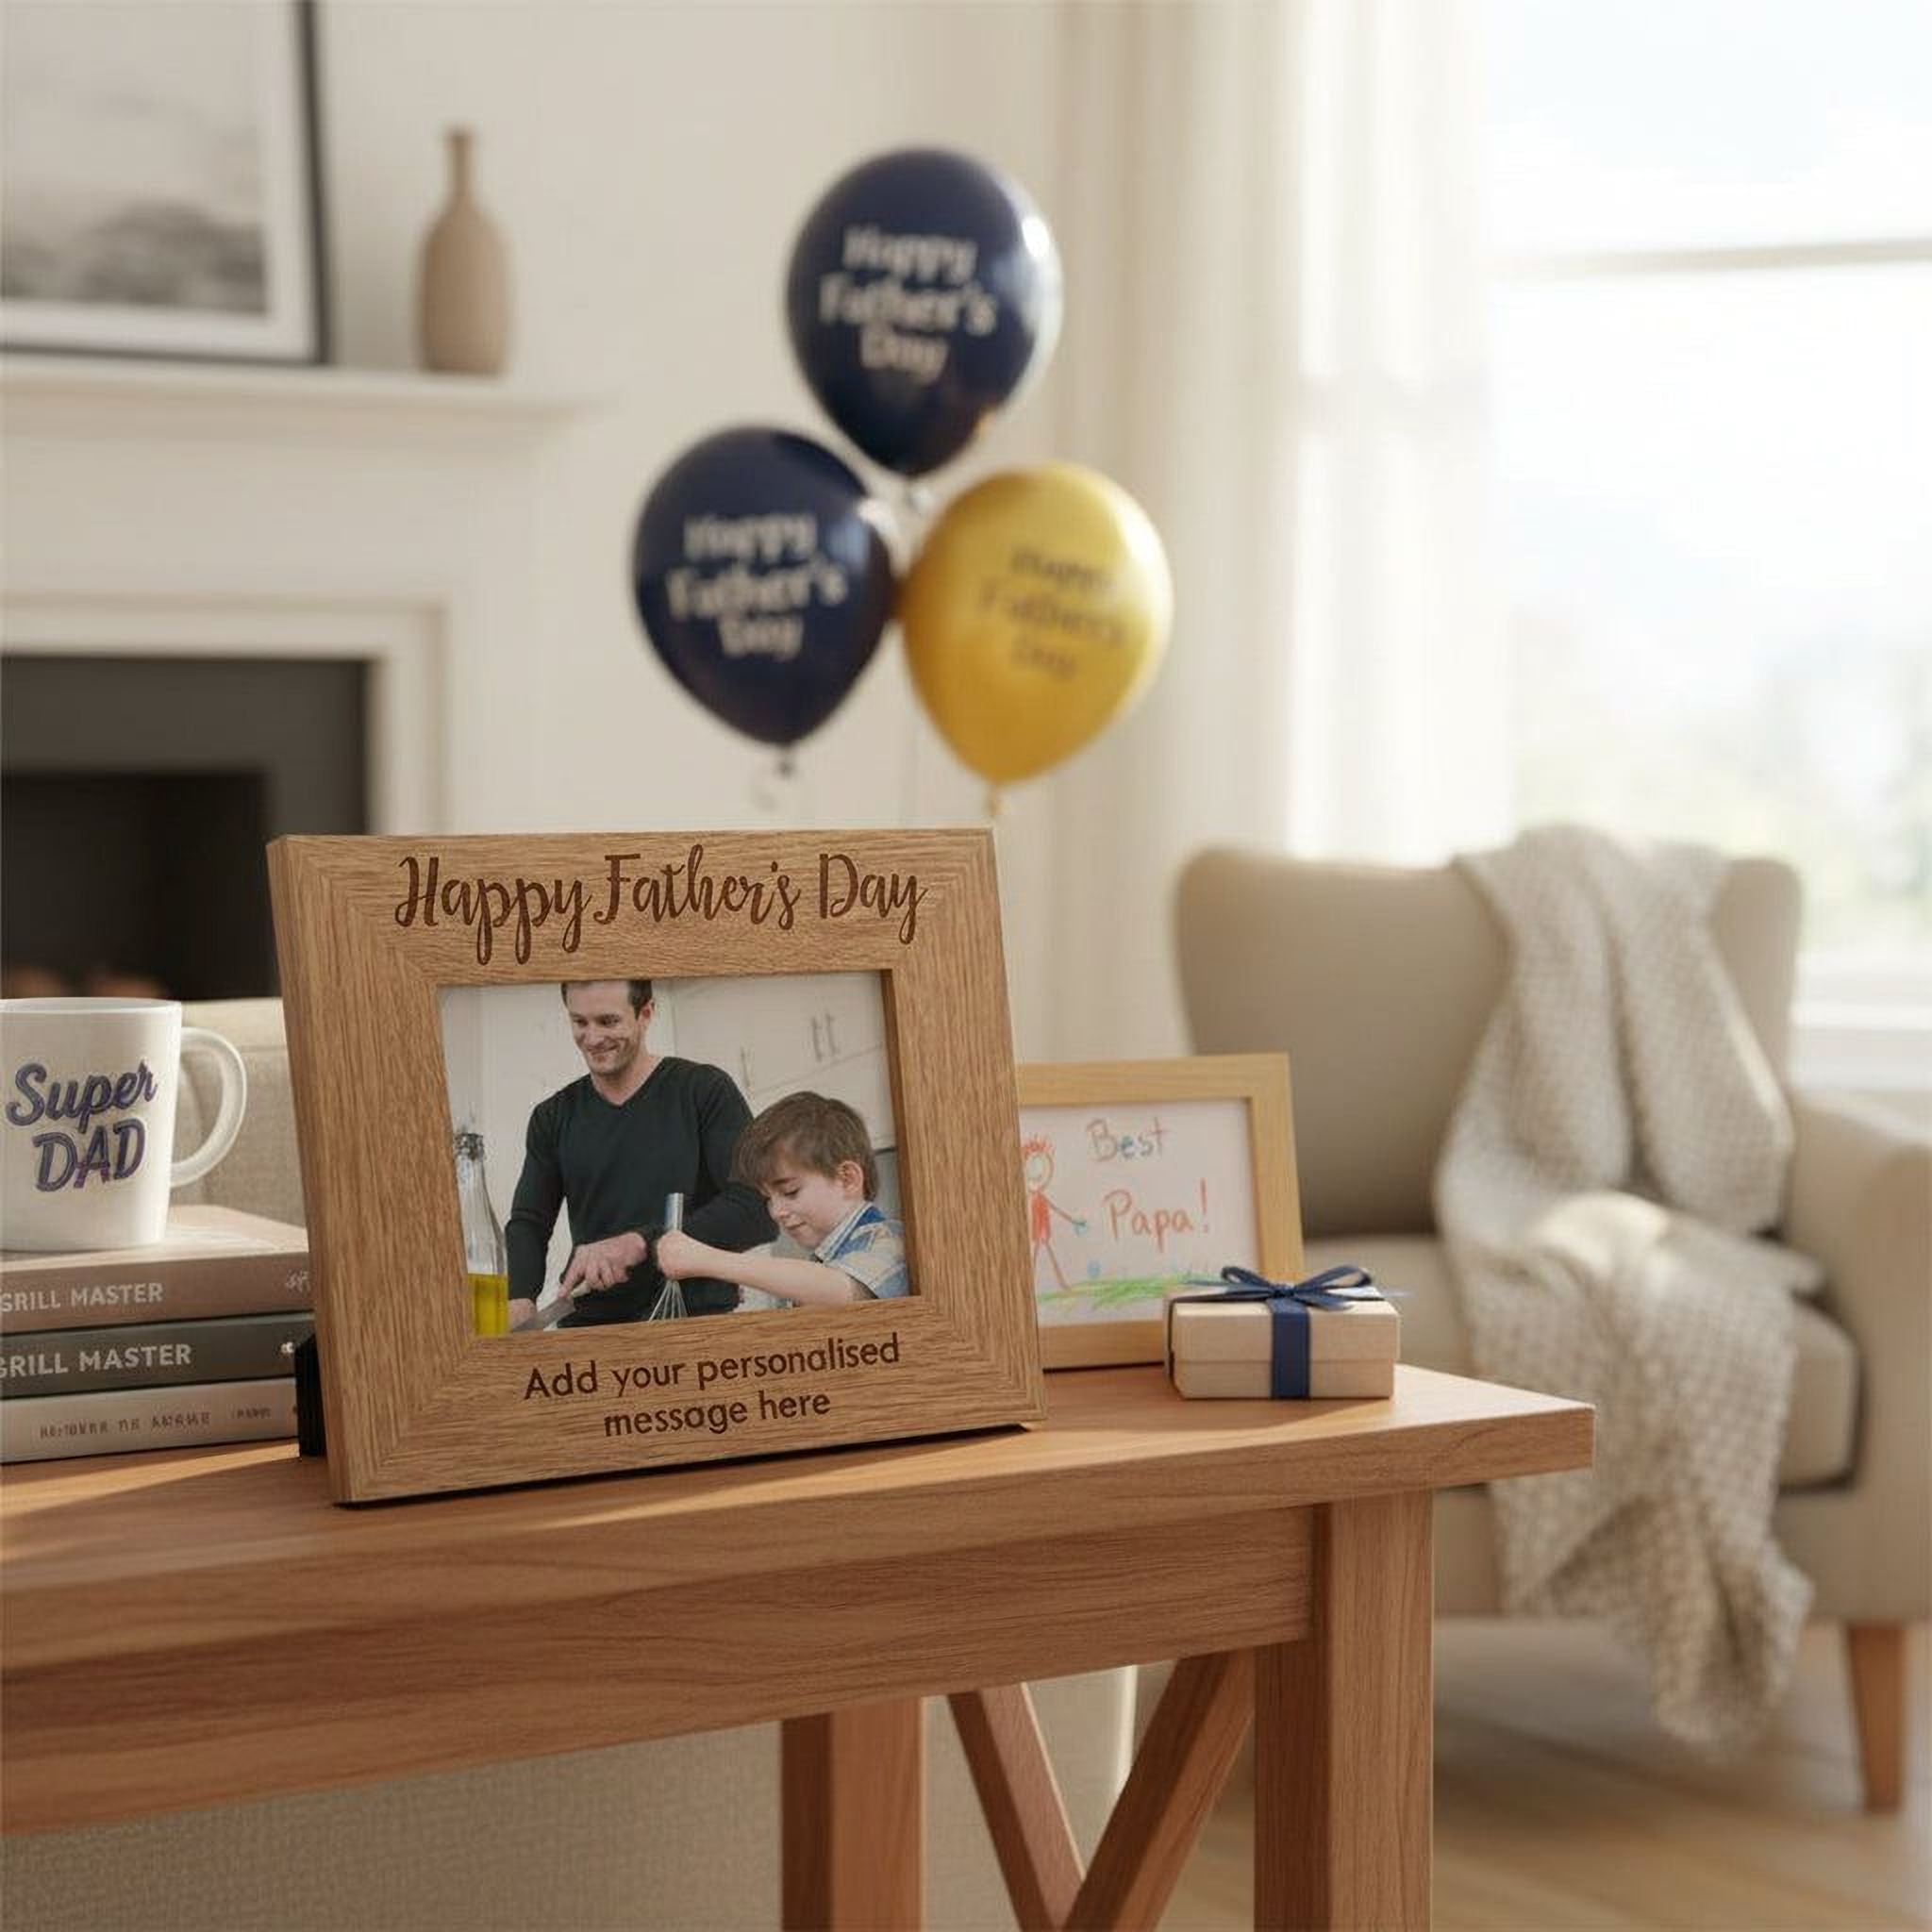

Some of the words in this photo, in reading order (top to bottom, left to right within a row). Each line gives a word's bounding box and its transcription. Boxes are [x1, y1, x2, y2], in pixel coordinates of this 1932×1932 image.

[843, 225, 977, 285] Happy
[394, 856, 591, 965] Happy
[592, 843, 801, 930] Father's
[819, 853, 928, 945] Day
[6, 1059, 158, 1134] Super
[32, 1116, 147, 1192] DAD
[1087, 1116, 1173, 1162] Best
[1104, 1178, 1210, 1253] Papa!
[71, 1282, 164, 1307] MASTER
[78, 1343, 192, 1373] MASTER
[524, 1359, 598, 1400] Add
[611, 1362, 684, 1397] your
[697, 1331, 900, 1391] personalised
[604, 1402, 748, 1437] message
[758, 1391, 831, 1421] here
